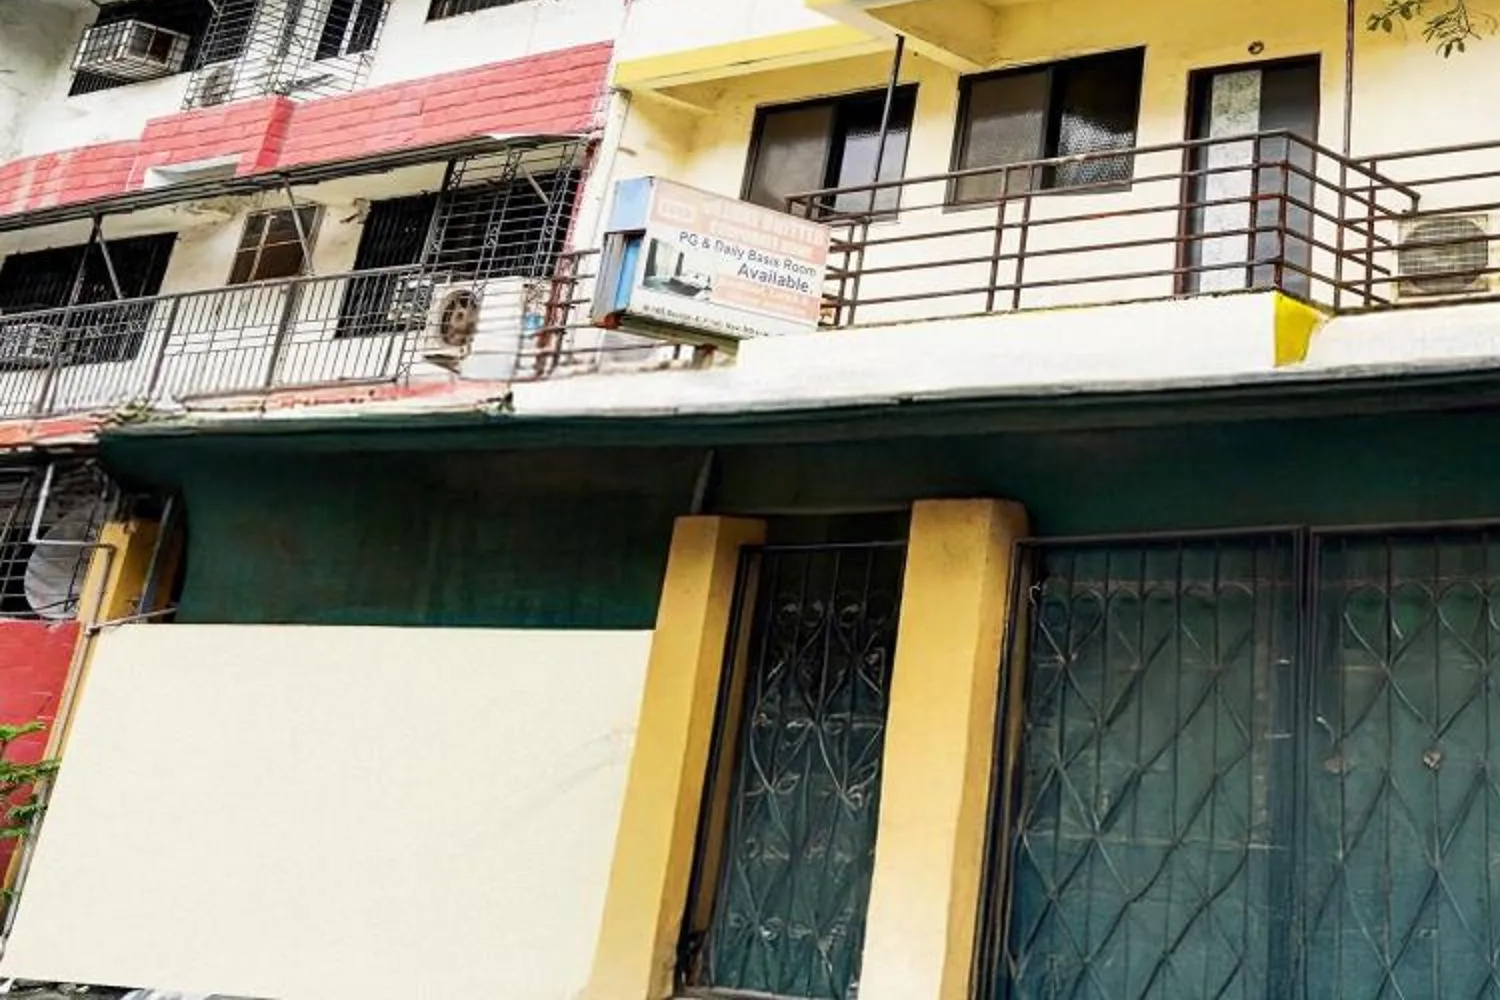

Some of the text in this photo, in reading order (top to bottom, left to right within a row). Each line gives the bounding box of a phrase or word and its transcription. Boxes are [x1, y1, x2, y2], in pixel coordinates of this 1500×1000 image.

[679, 231, 698, 247] PG
[701, 237, 712, 249] &
[714, 239, 745, 261] Daily
[747, 249, 780, 268] Basis
[783, 259, 817, 277] Room
